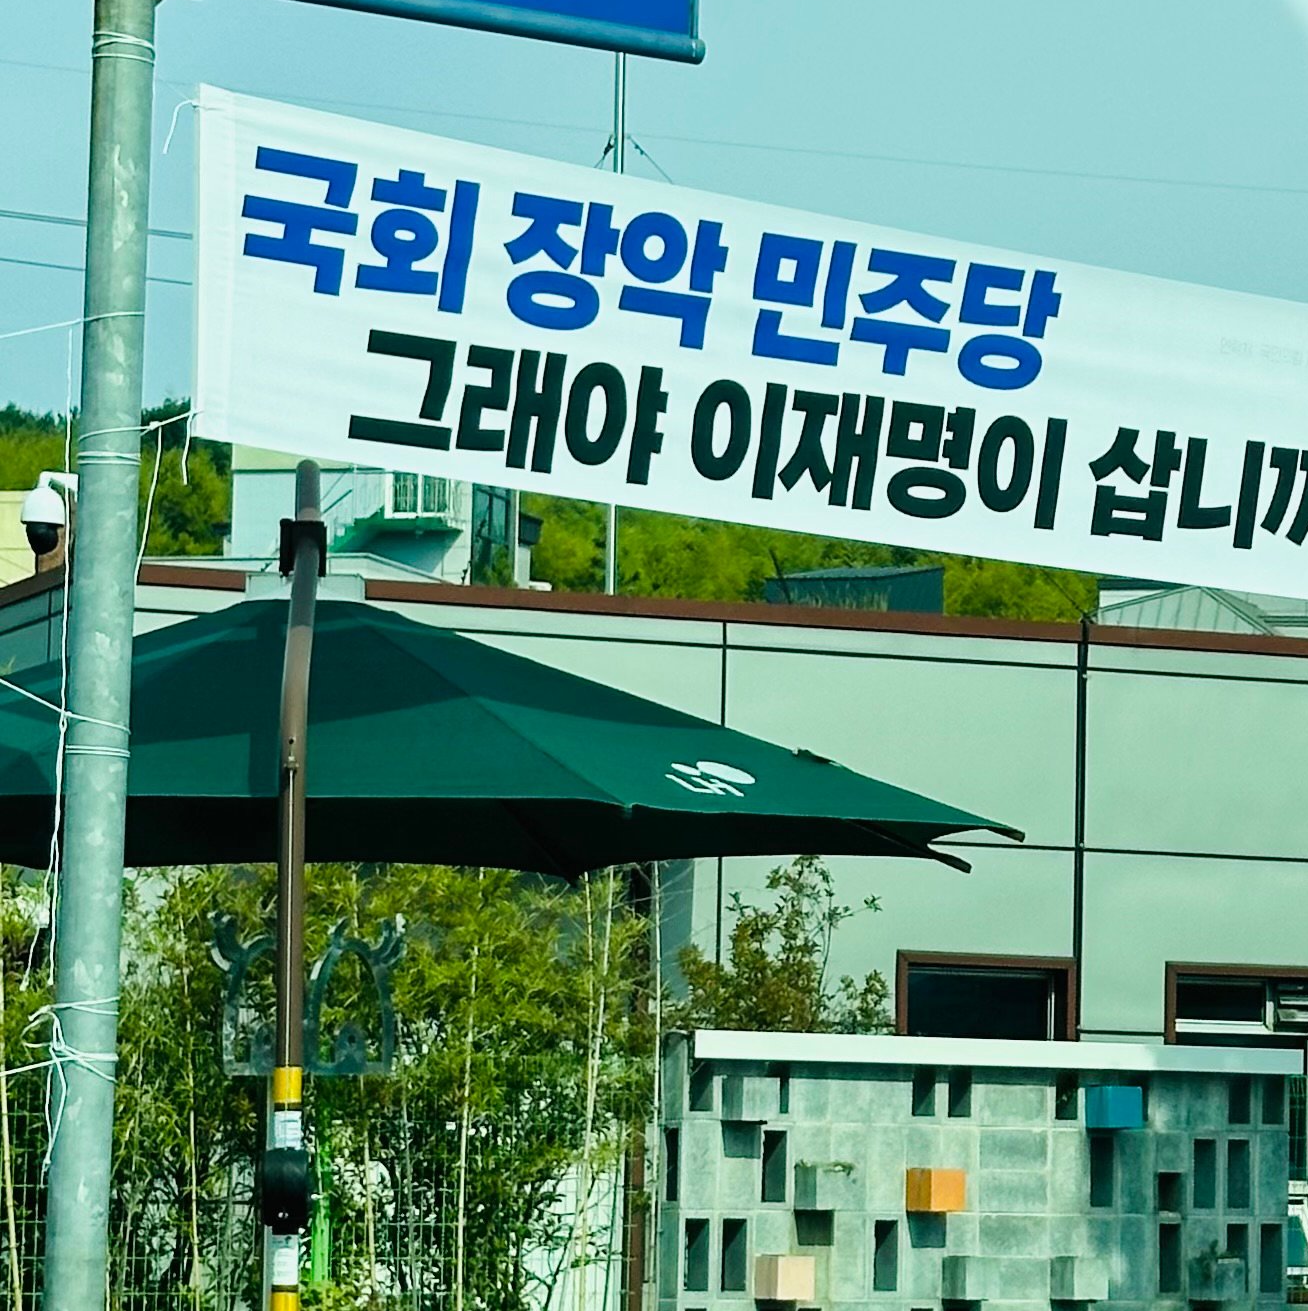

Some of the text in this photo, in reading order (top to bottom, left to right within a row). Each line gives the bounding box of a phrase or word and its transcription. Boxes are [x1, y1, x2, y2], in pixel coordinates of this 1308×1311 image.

[242, 146, 1061, 391] 국회 장악 민주당
[347, 329, 669, 486] 그래야
[690, 379, 1068, 531] 이재명이
